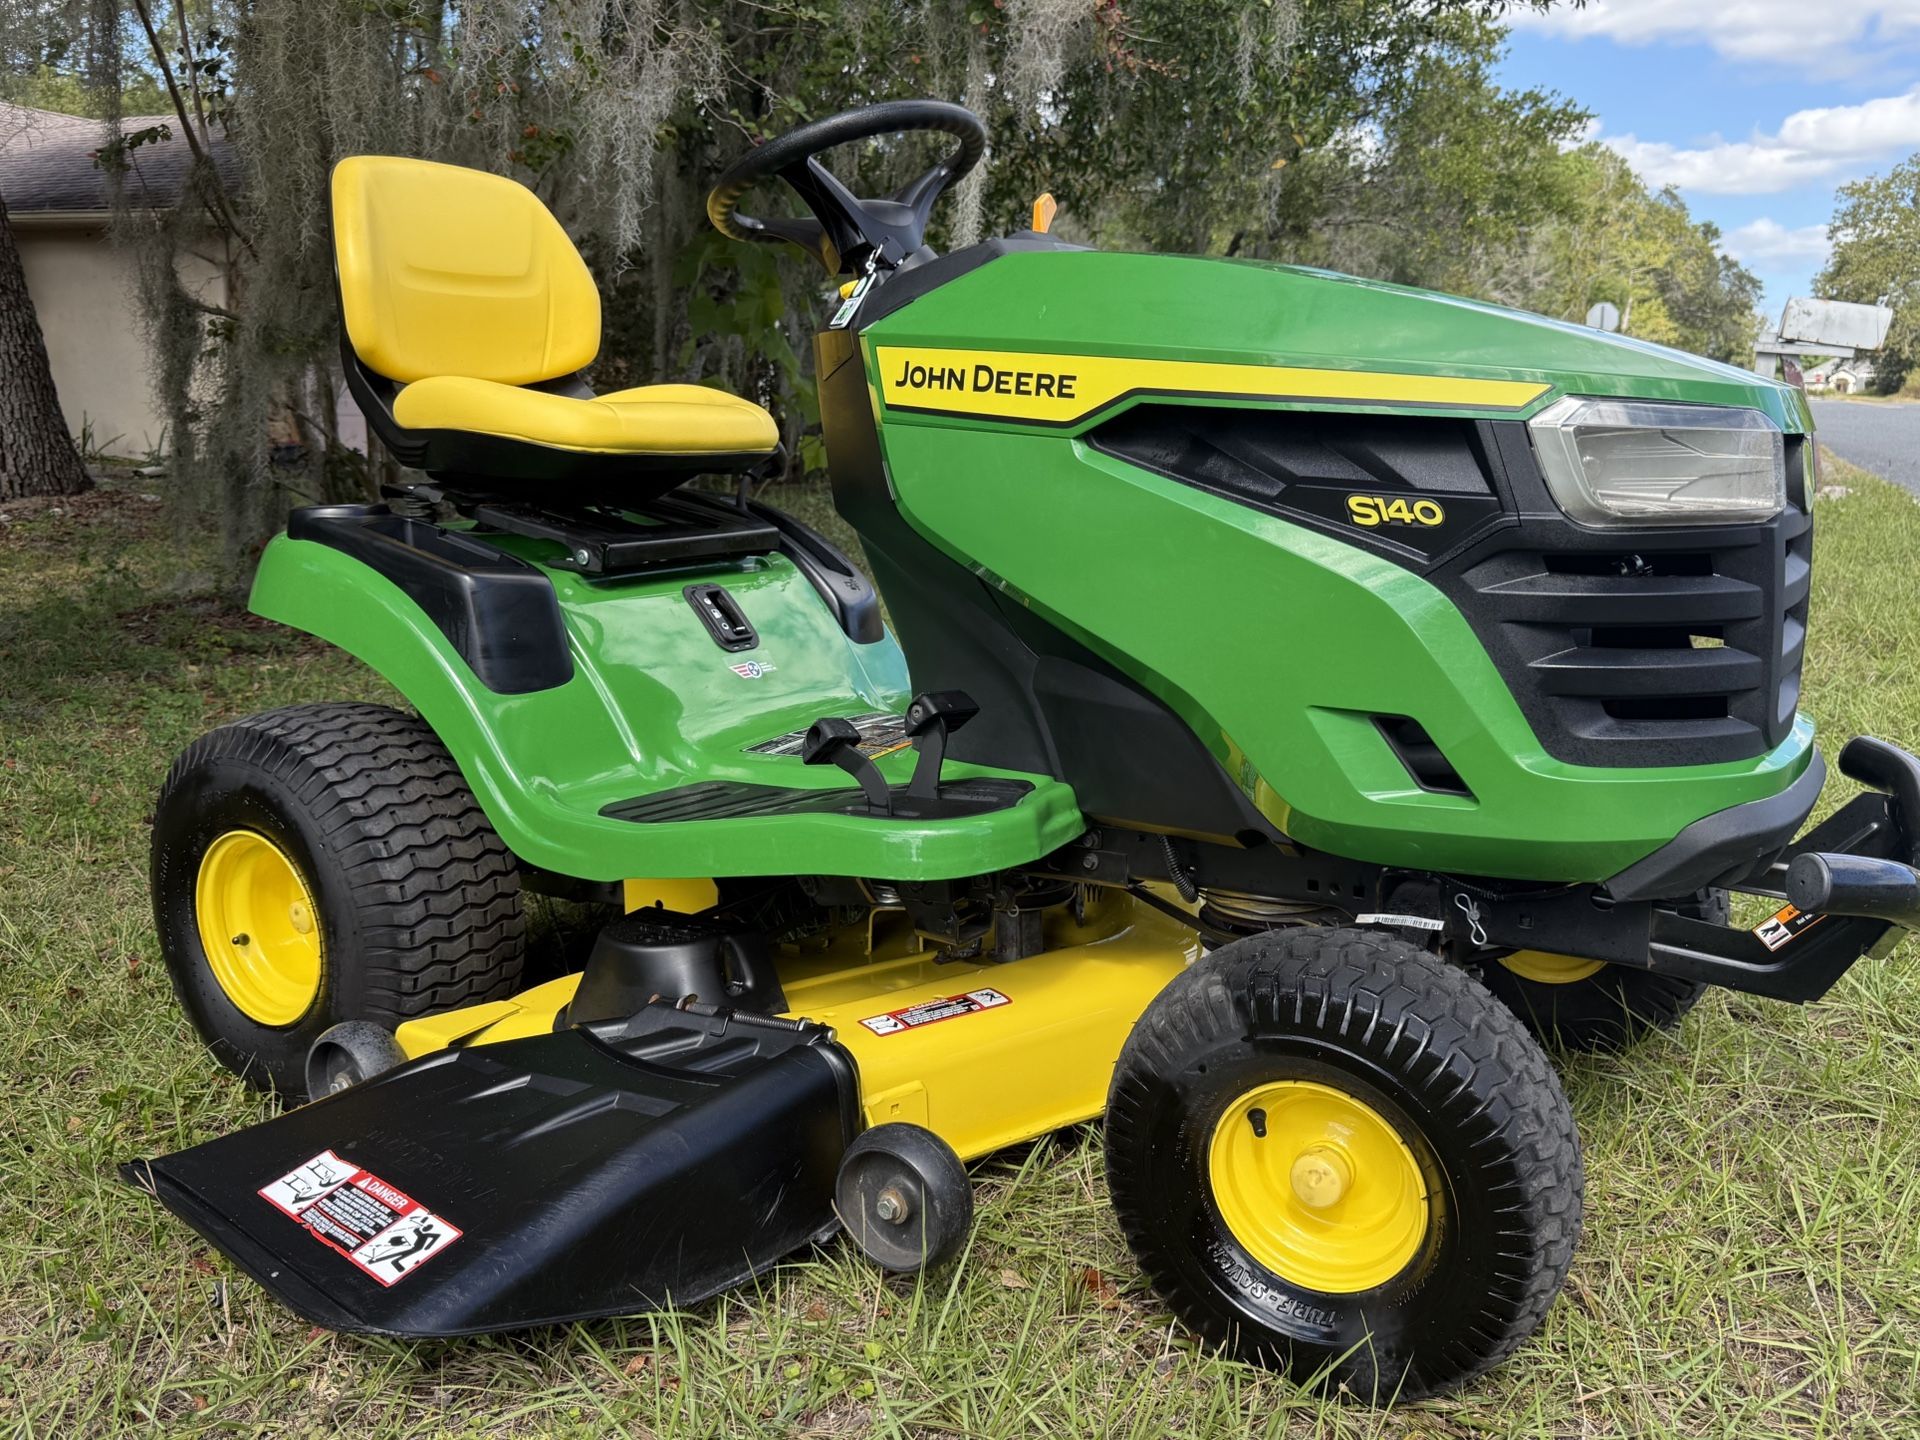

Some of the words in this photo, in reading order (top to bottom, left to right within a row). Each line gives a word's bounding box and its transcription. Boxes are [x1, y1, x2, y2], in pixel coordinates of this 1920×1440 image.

[895, 361, 966, 391] JOHN
[972, 364, 1077, 399] DEERE
[1347, 495, 1444, 526] S140
[367, 1181, 409, 1210] DANGER
